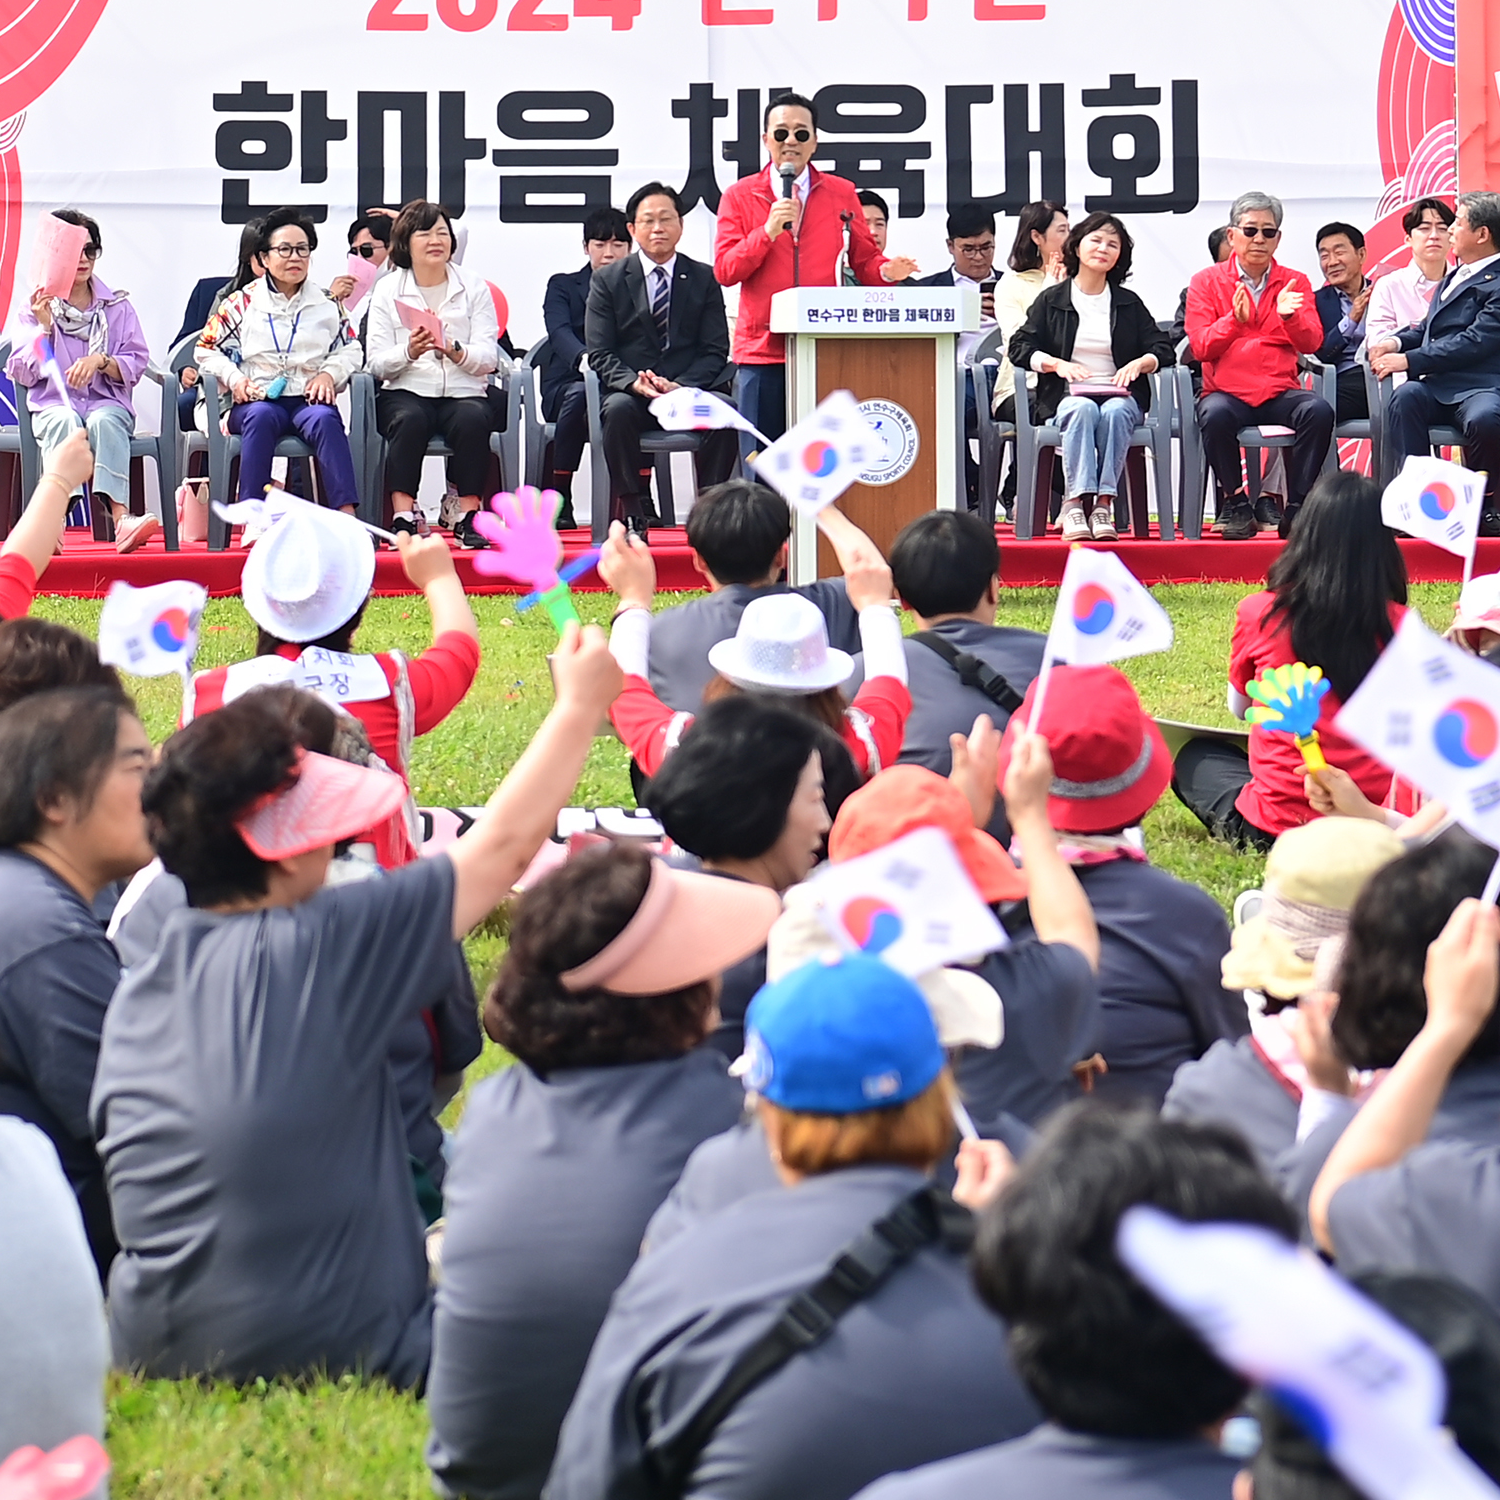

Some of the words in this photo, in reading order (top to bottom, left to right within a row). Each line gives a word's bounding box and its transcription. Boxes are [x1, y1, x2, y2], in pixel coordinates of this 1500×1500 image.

[213, 81, 619, 224] 한마음
[864, 291, 895, 303] 2024
[807, 308, 858, 323] 연수구민
[862, 308, 900, 323] 한마음
[904, 308, 955, 323] 체육대회
